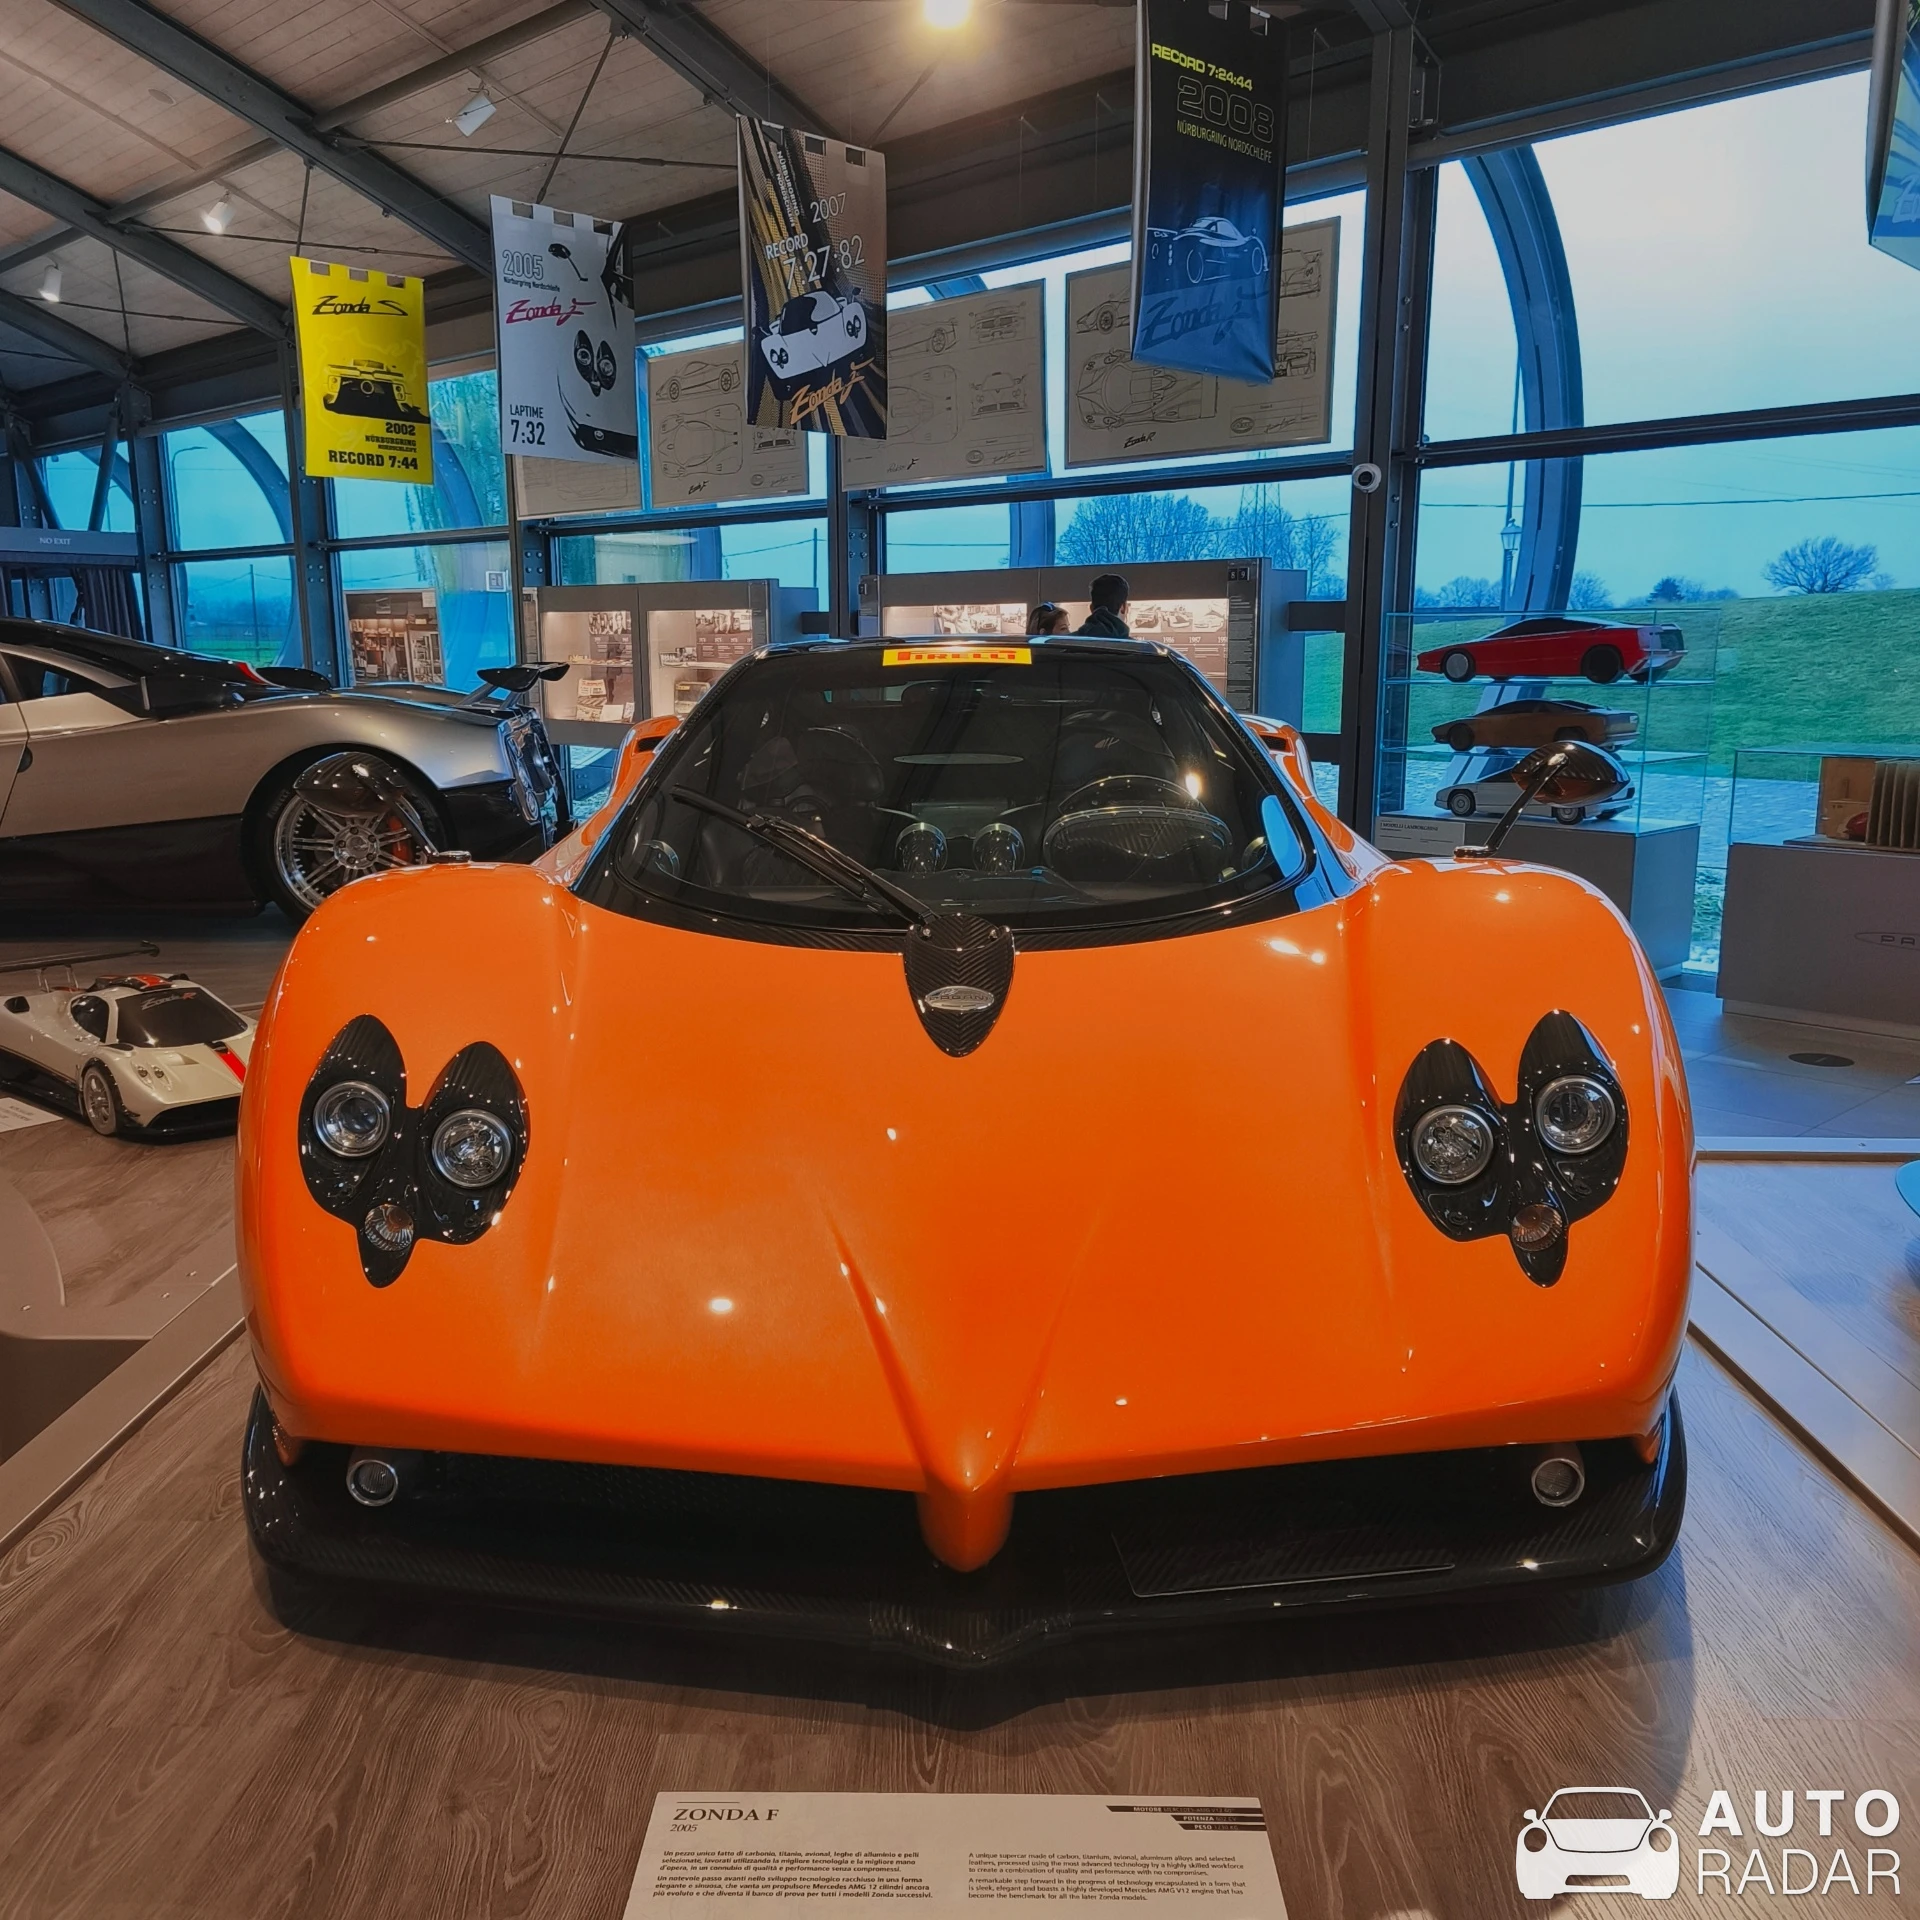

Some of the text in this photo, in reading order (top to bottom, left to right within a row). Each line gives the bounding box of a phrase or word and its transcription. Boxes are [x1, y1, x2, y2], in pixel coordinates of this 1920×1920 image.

[1152, 43, 1253, 91] RECORD 7:24:44
[1177, 75, 1274, 143] 2008
[1176, 120, 1272, 163] NÜRBURGRING NORDSCHLEIFE
[810, 192, 846, 223] 2007
[765, 233, 809, 260] RECORD
[502, 249, 543, 280] 2005
[783, 235, 865, 290] 7:27:82
[510, 404, 544, 419] LAPTIME
[385, 422, 416, 436] 2002
[511, 419, 545, 446] 7:32
[328, 450, 418, 470] RECORD 7:44
[40, 537, 53, 545] NO
[670, 1824, 698, 1832] 2005
[673, 1808, 779, 1821] ZONDA F
[753, 1865, 777, 1873] qualità
